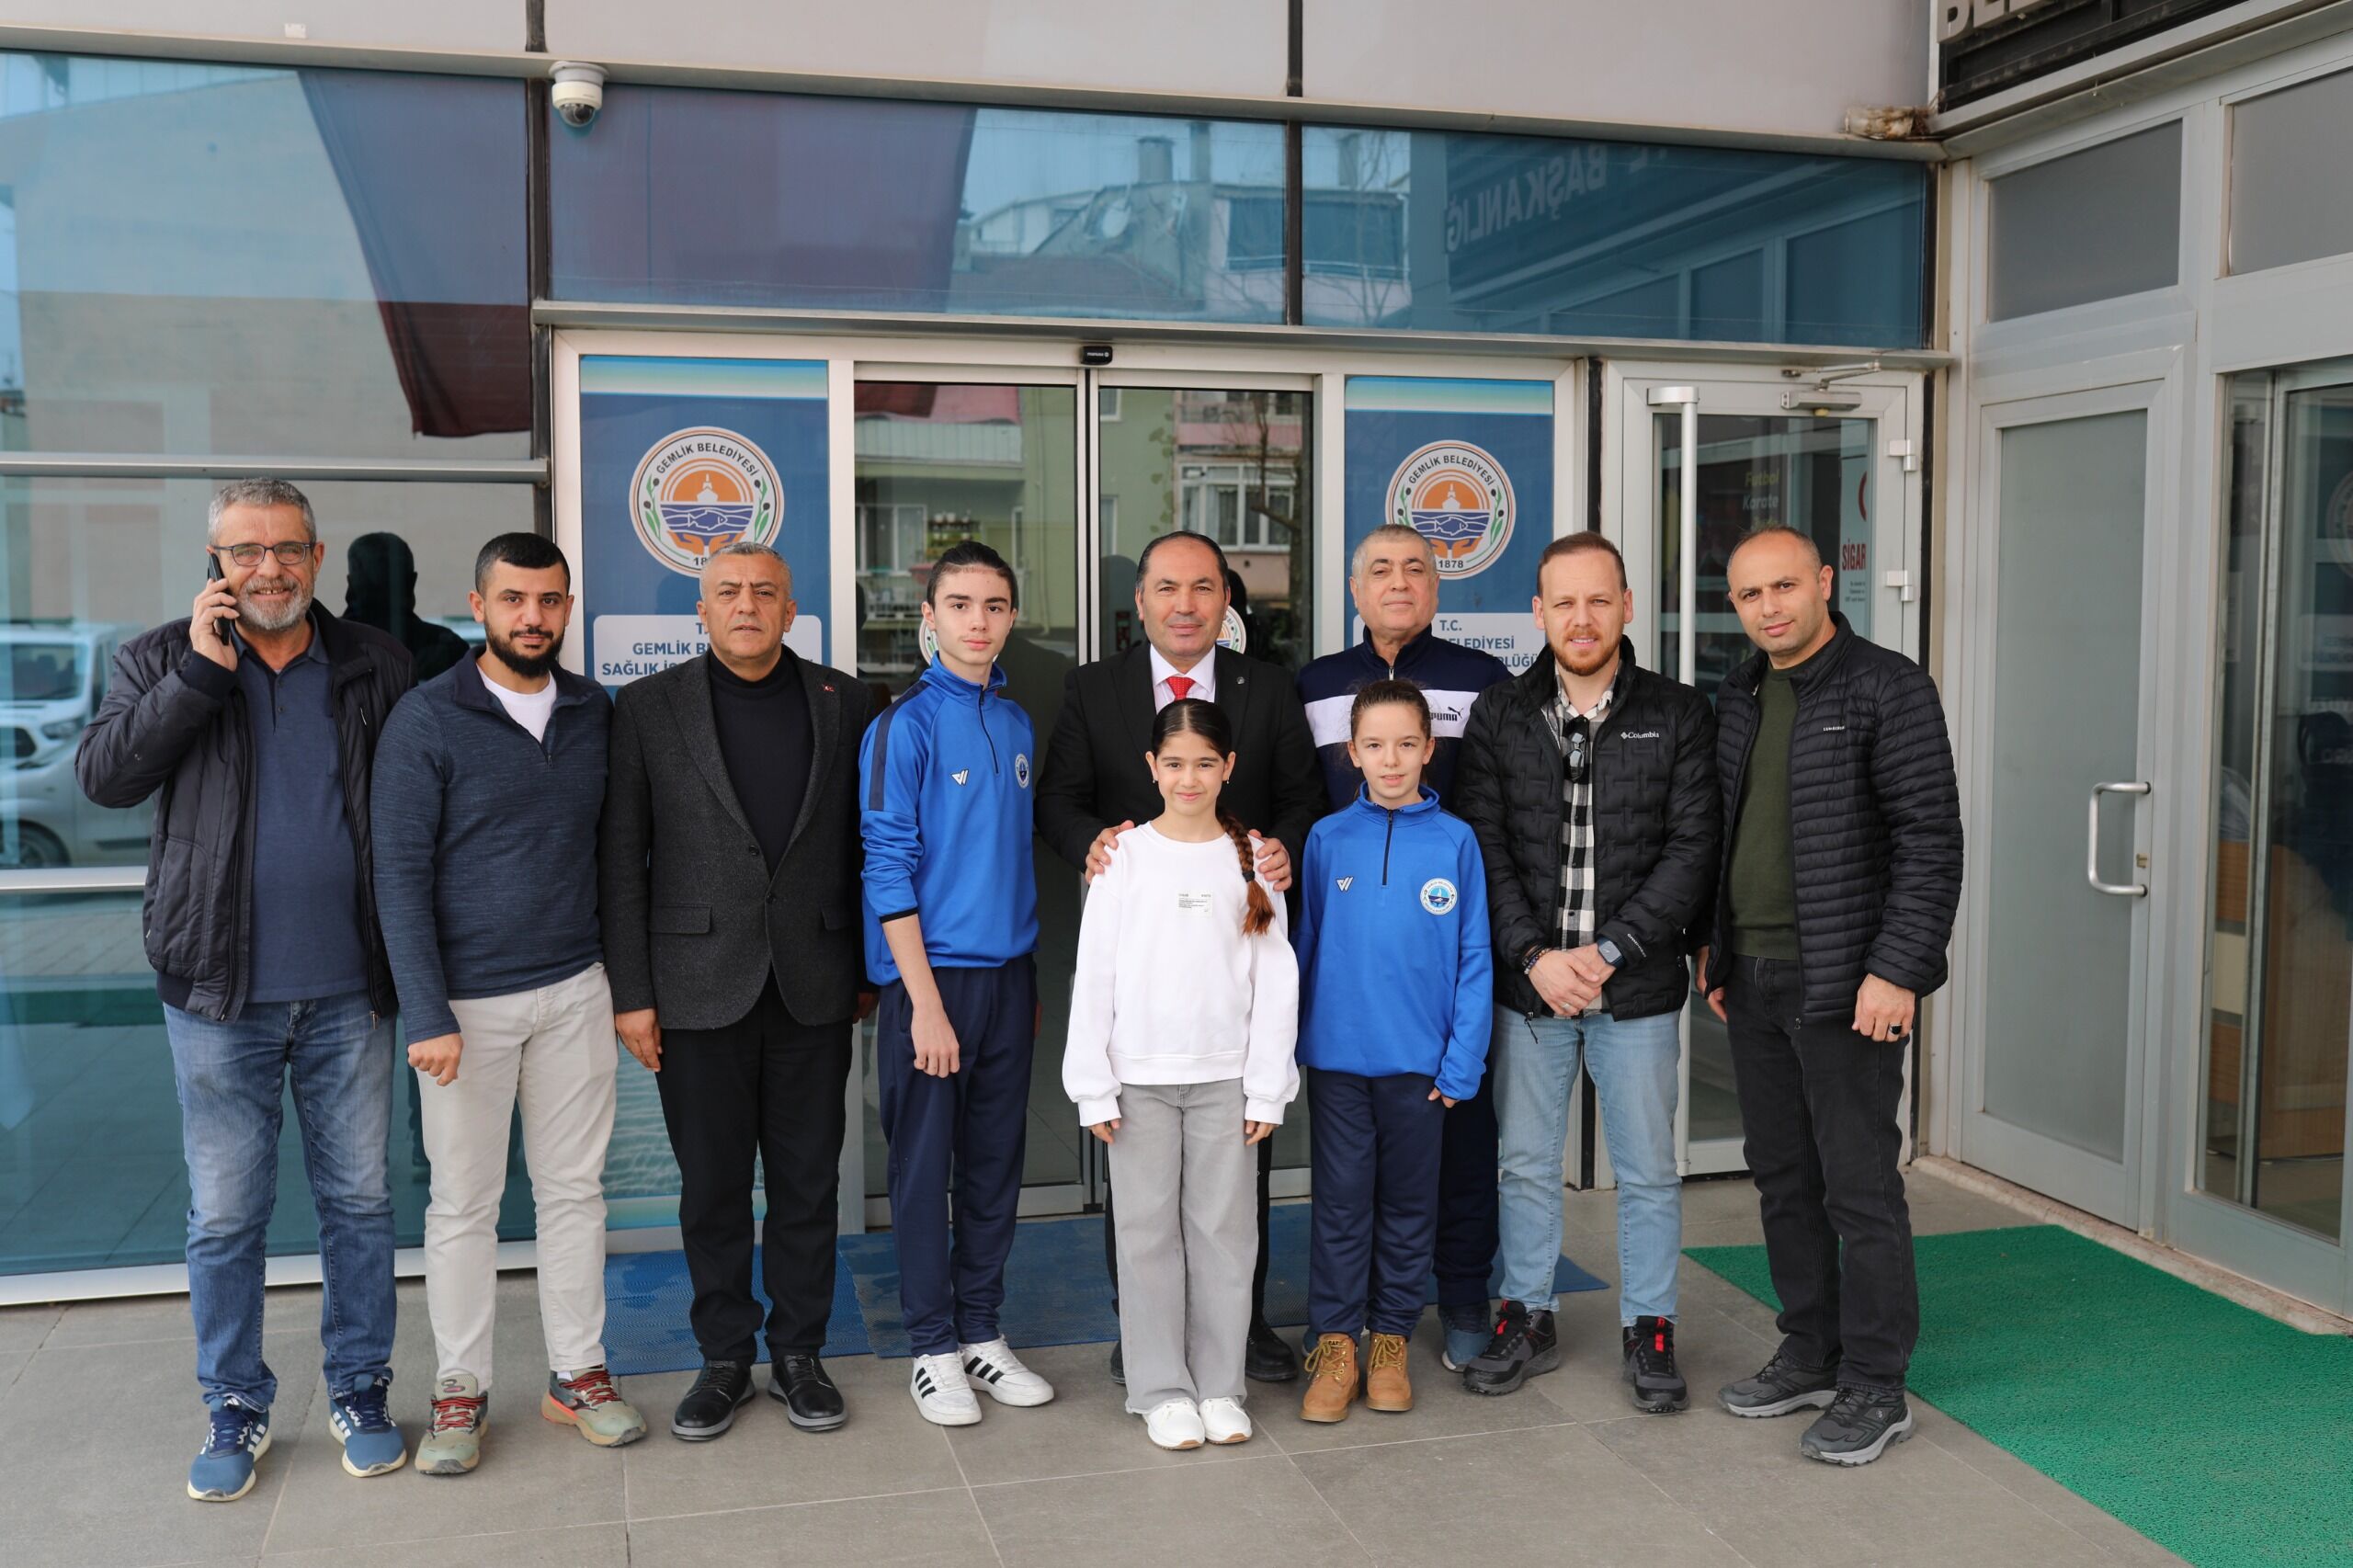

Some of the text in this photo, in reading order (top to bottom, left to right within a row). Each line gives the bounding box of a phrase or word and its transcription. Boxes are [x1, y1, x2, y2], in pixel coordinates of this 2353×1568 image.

[656, 443, 759, 477] GEMLİK BELEDİYESİ
[1408, 455, 1496, 486] GEMLİK BELEDİYESİ
[1438, 559, 1464, 569] 1878
[1439, 619, 1462, 631] T.C.
[632, 640, 691, 655] GEMLİK
[1445, 635, 1515, 649] ELEDİYESİ
[602, 660, 659, 676] SAĞLIK
[1430, 712, 1458, 722] PUMA
[1628, 731, 1660, 739] Columbia
